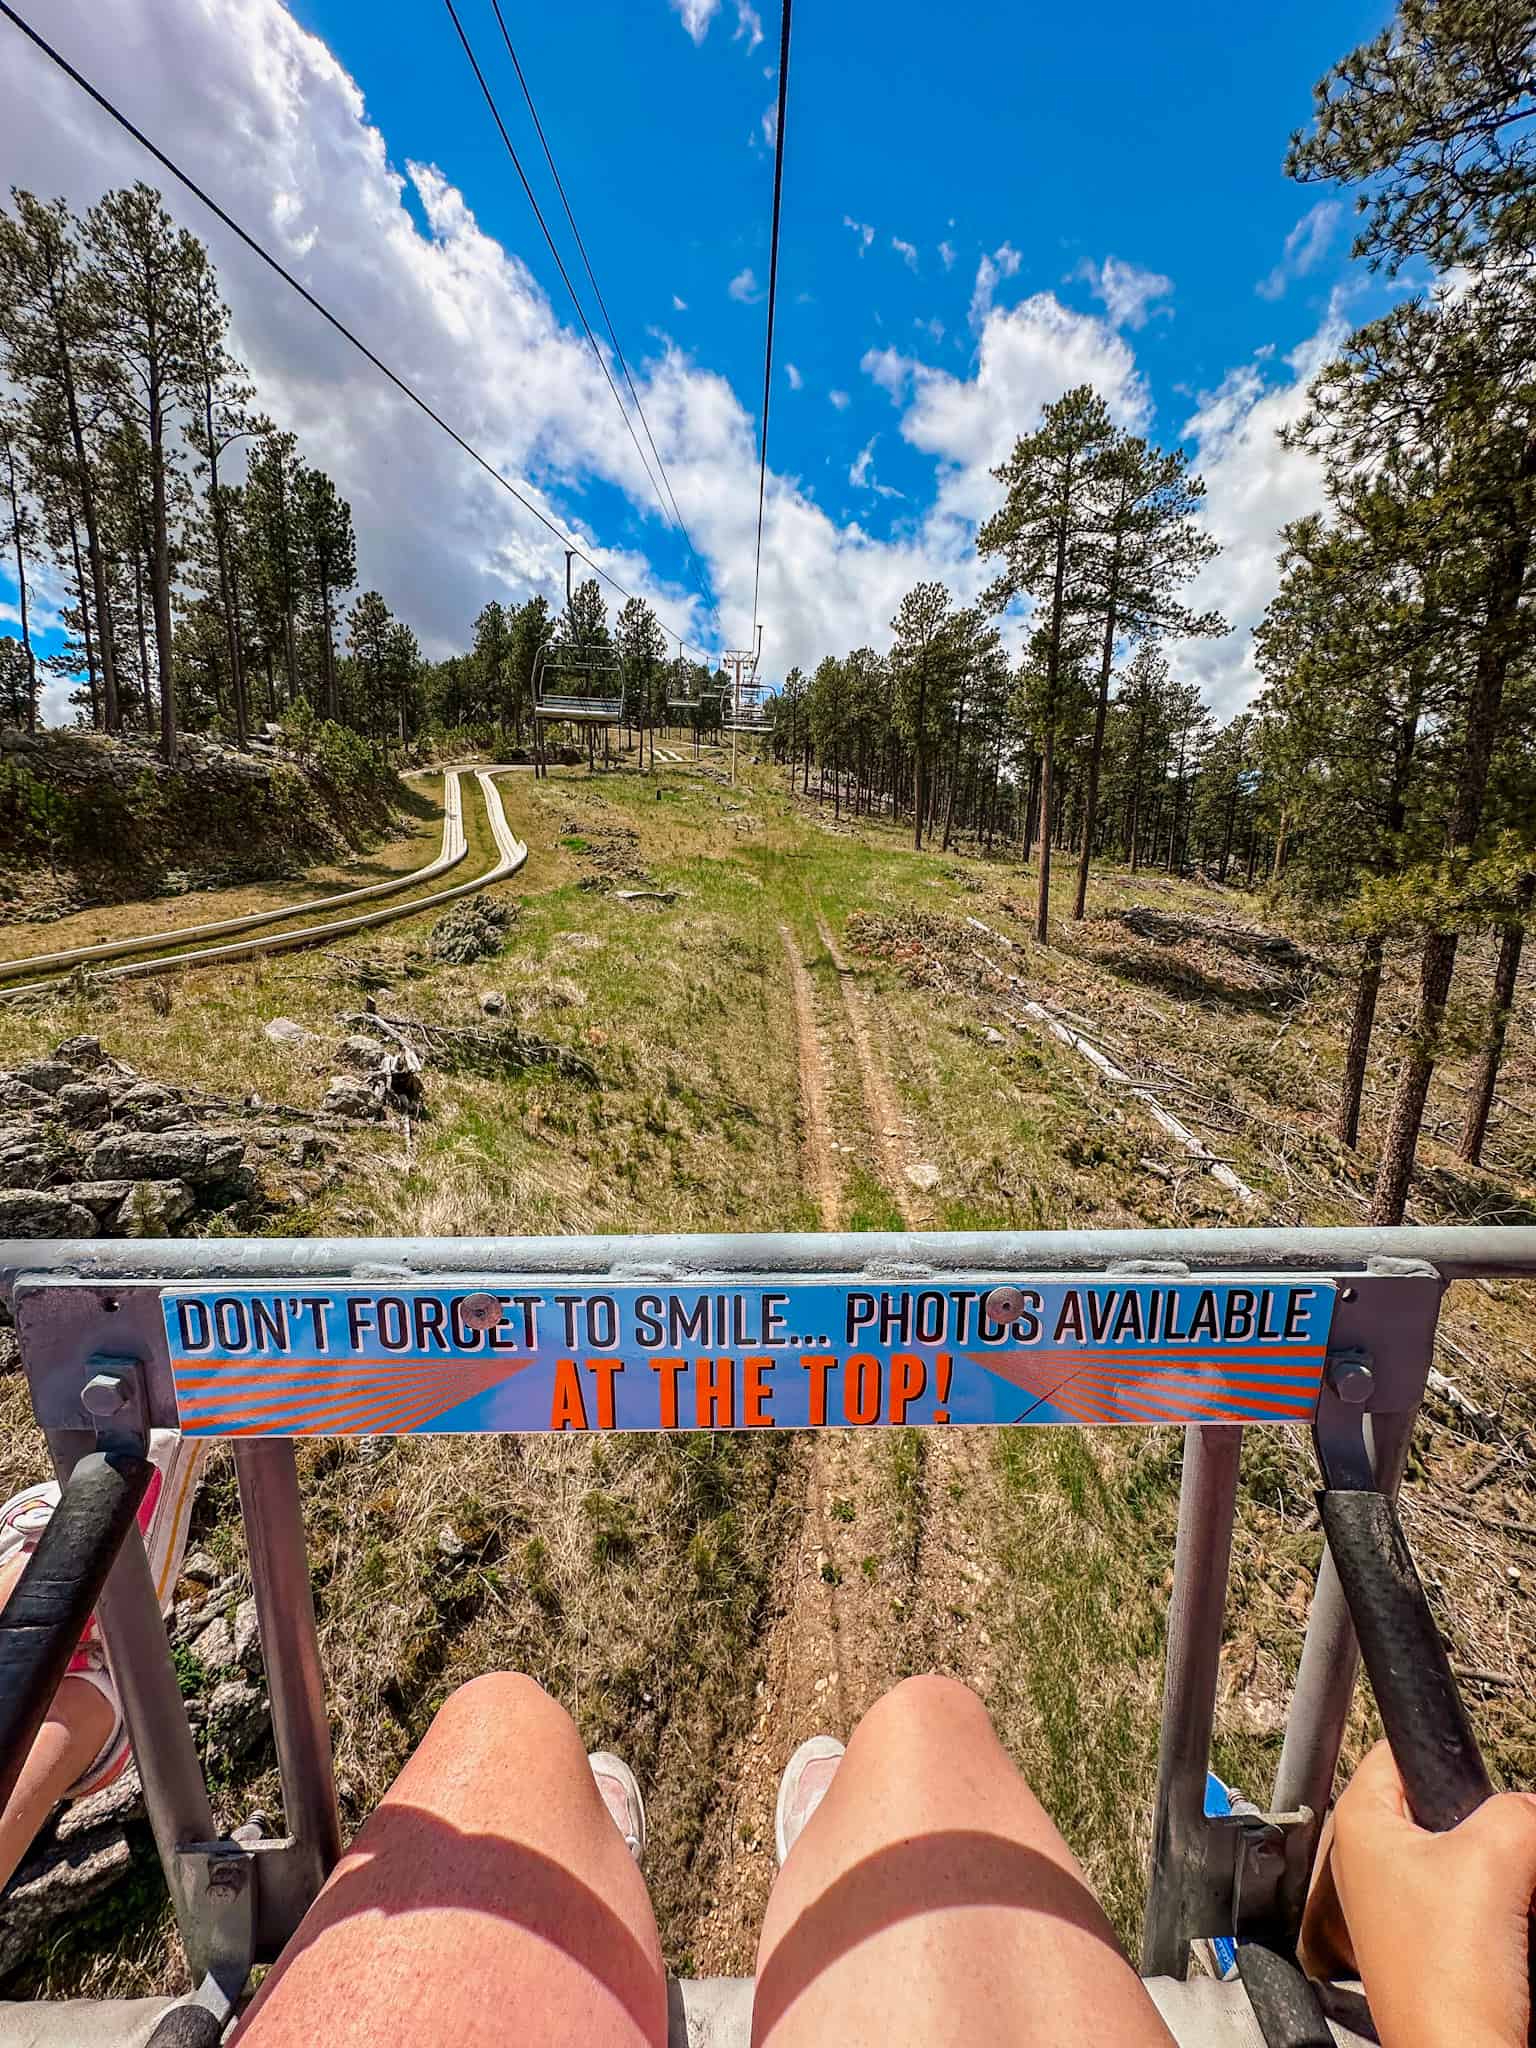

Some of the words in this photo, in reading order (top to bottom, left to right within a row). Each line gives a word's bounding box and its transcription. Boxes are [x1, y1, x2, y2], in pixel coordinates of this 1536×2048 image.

[180, 1298, 332, 1354] DON'T
[348, 1297, 546, 1353] FORGET
[555, 1296, 617, 1350] TO
[635, 1294, 832, 1350] SMILE...
[846, 1291, 1045, 1346] PHOTOS
[1053, 1290, 1316, 1344] AVAILABLE
[550, 1355, 626, 1430] AT
[648, 1355, 775, 1428] THE
[799, 1353, 954, 1425] TOP!
